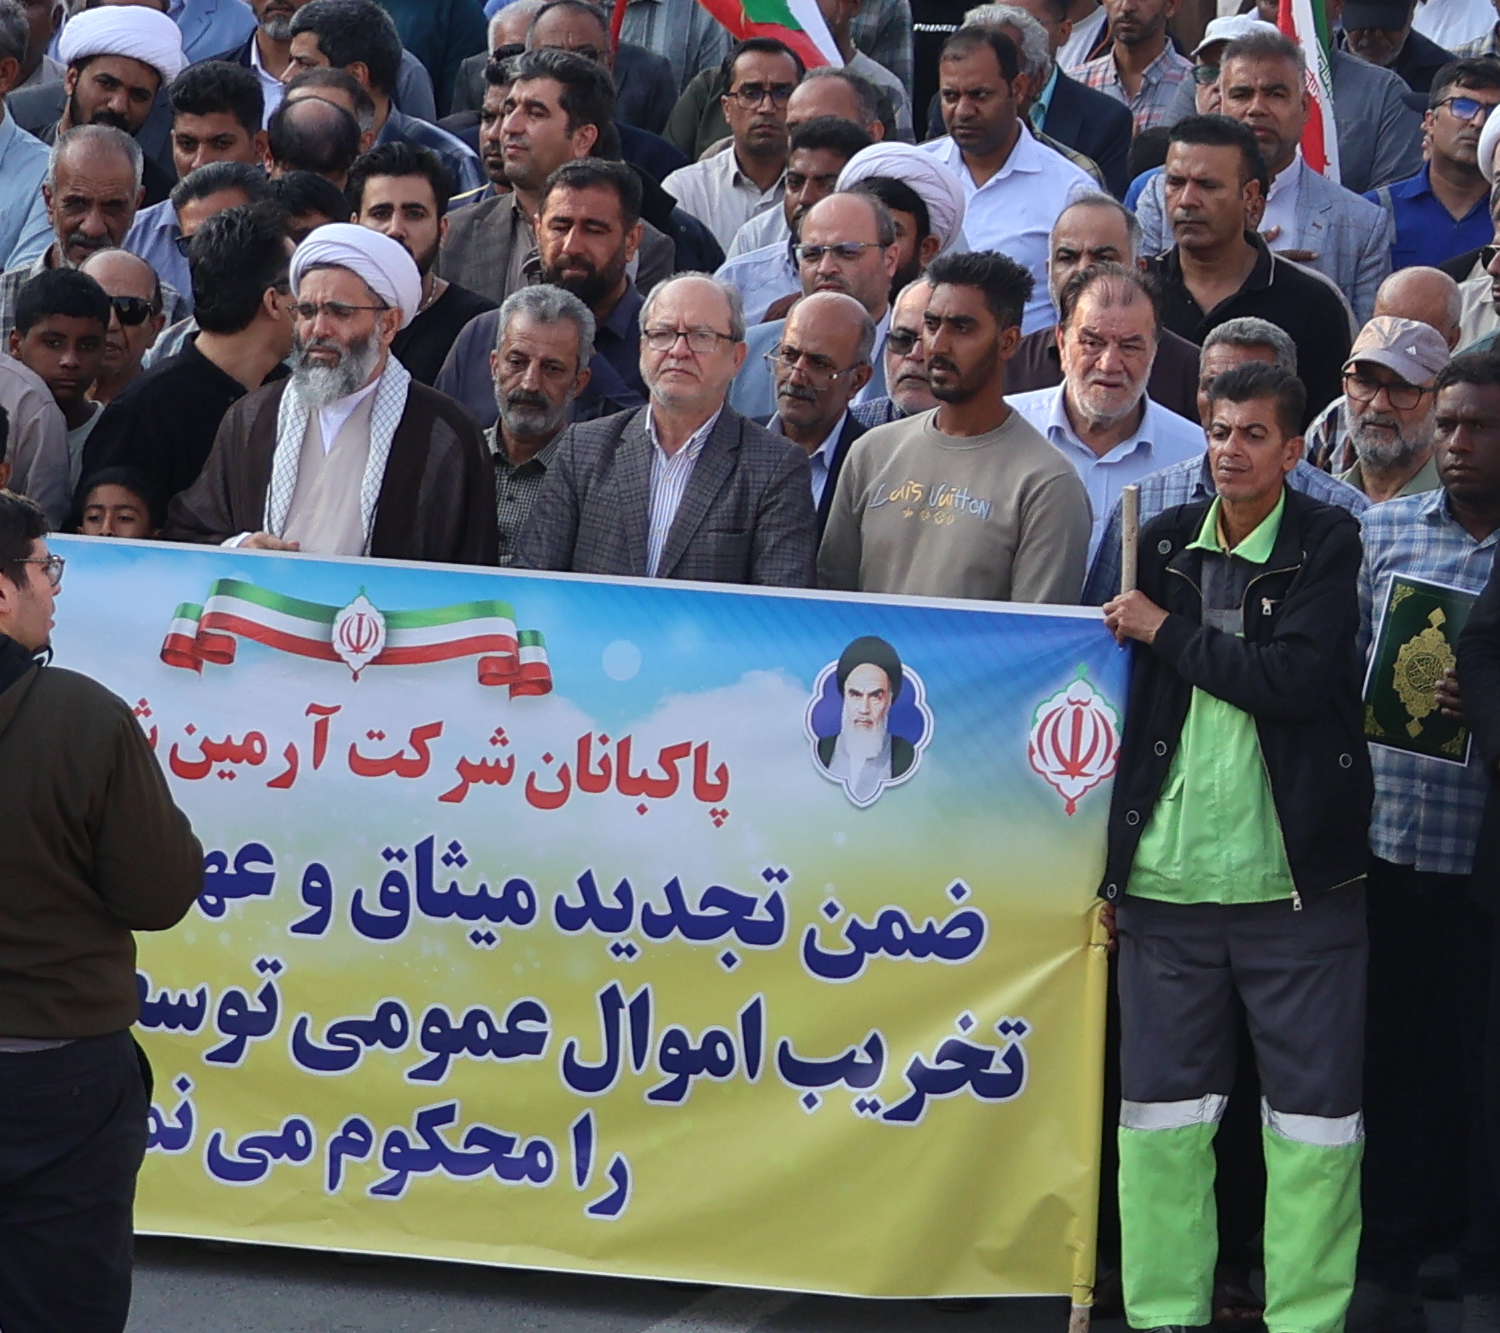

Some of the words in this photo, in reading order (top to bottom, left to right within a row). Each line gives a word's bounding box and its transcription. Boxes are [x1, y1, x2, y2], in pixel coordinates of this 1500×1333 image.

[169, 703, 342, 790] آرمین
[348, 720, 517, 804] شرکت
[525, 732, 730, 830] پاکبانان
[290, 860, 333, 938] و
[350, 835, 537, 948] میثاق
[554, 865, 790, 971] تجدید
[802, 881, 986, 980] ضمن
[292, 998, 551, 1084] عمومی
[561, 981, 764, 1102] اموال
[778, 1013, 1029, 1123] تخریب
[207, 1115, 312, 1182] می
[328, 1102, 556, 1197] محکوم
[573, 1110, 631, 1216] را
